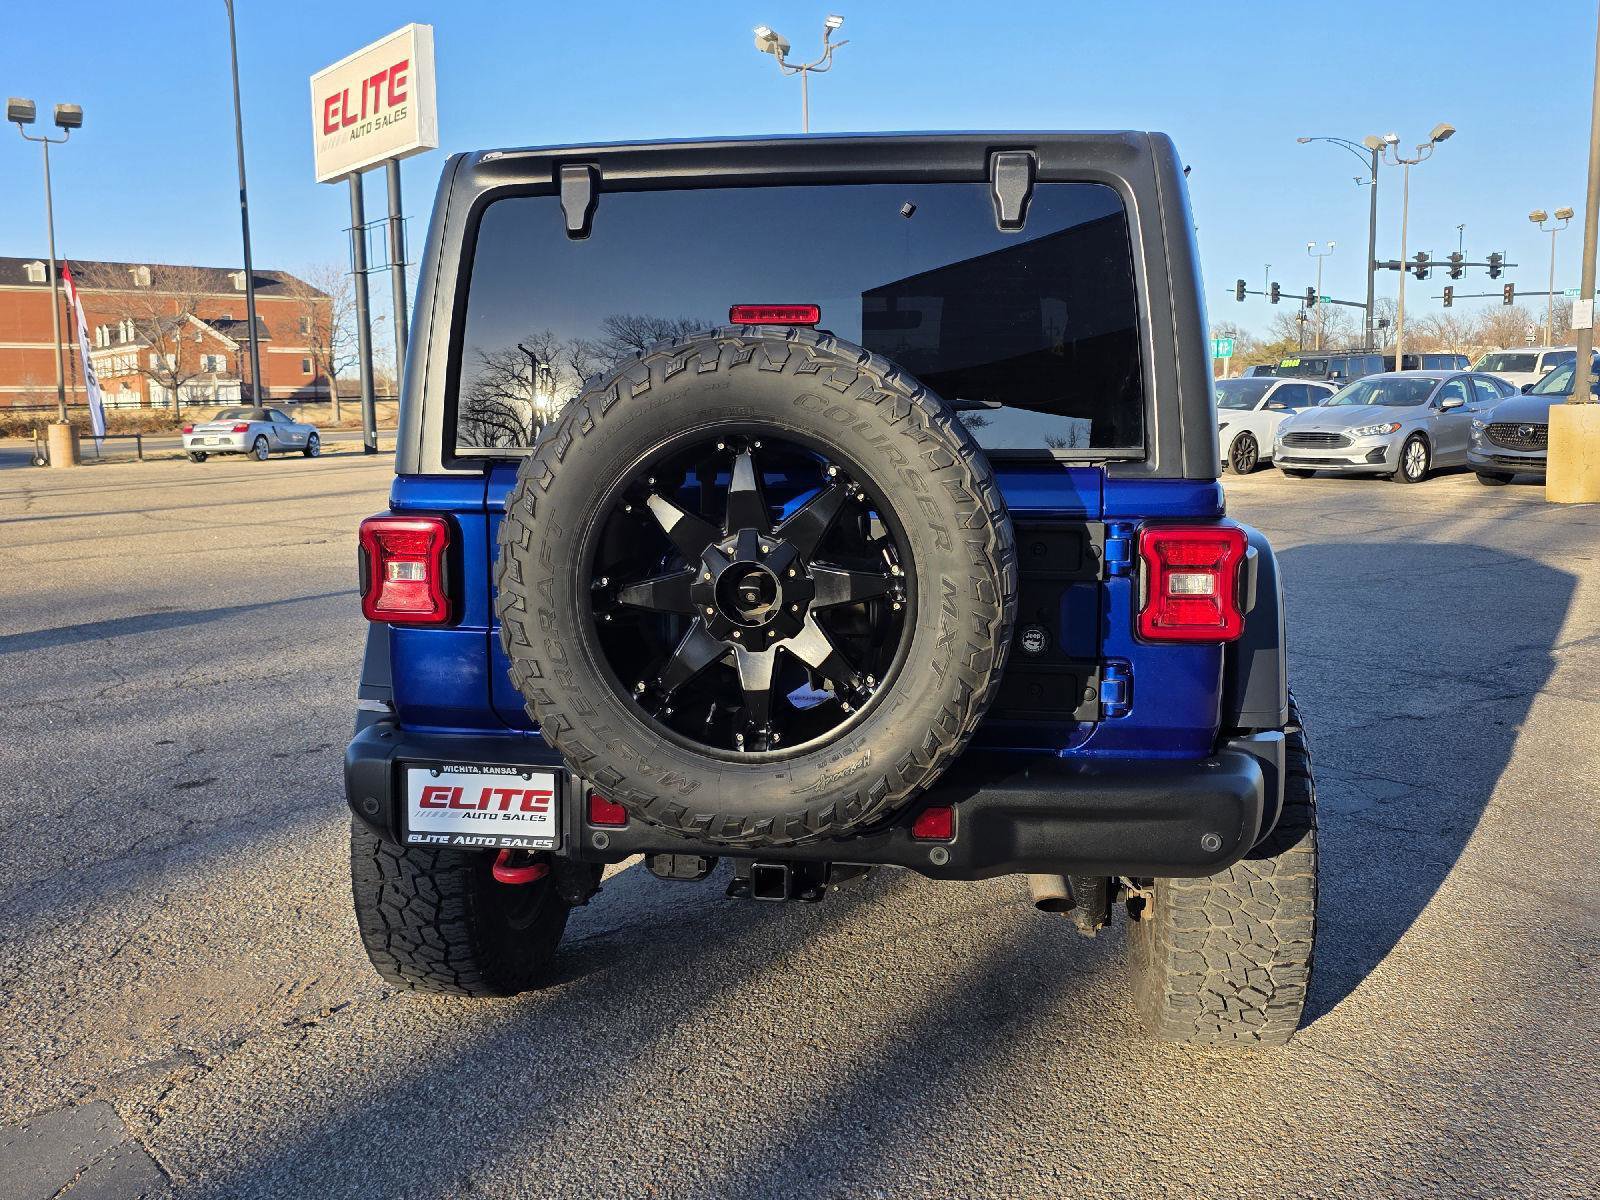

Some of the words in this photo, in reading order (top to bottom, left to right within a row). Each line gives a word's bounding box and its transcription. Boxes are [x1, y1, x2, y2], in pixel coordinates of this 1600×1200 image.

[324, 59, 409, 136] ELITE
[350, 122, 372, 141] AUTO
[374, 107, 407, 130] SALES
[792, 391, 953, 551] COURSER
[931, 575, 959, 691] MXT
[537, 509, 703, 795] MASTERCRAFT
[443, 765, 481, 774] WICHITA,
[483, 766, 518, 775] KANSAS
[419, 785, 553, 812] ELITE
[462, 812, 498, 820] AUTO
[501, 813, 547, 822] SALES
[407, 834, 450, 843] ELITE
[453, 835, 497, 846] AUTO
[500, 837, 554, 848] SALES
